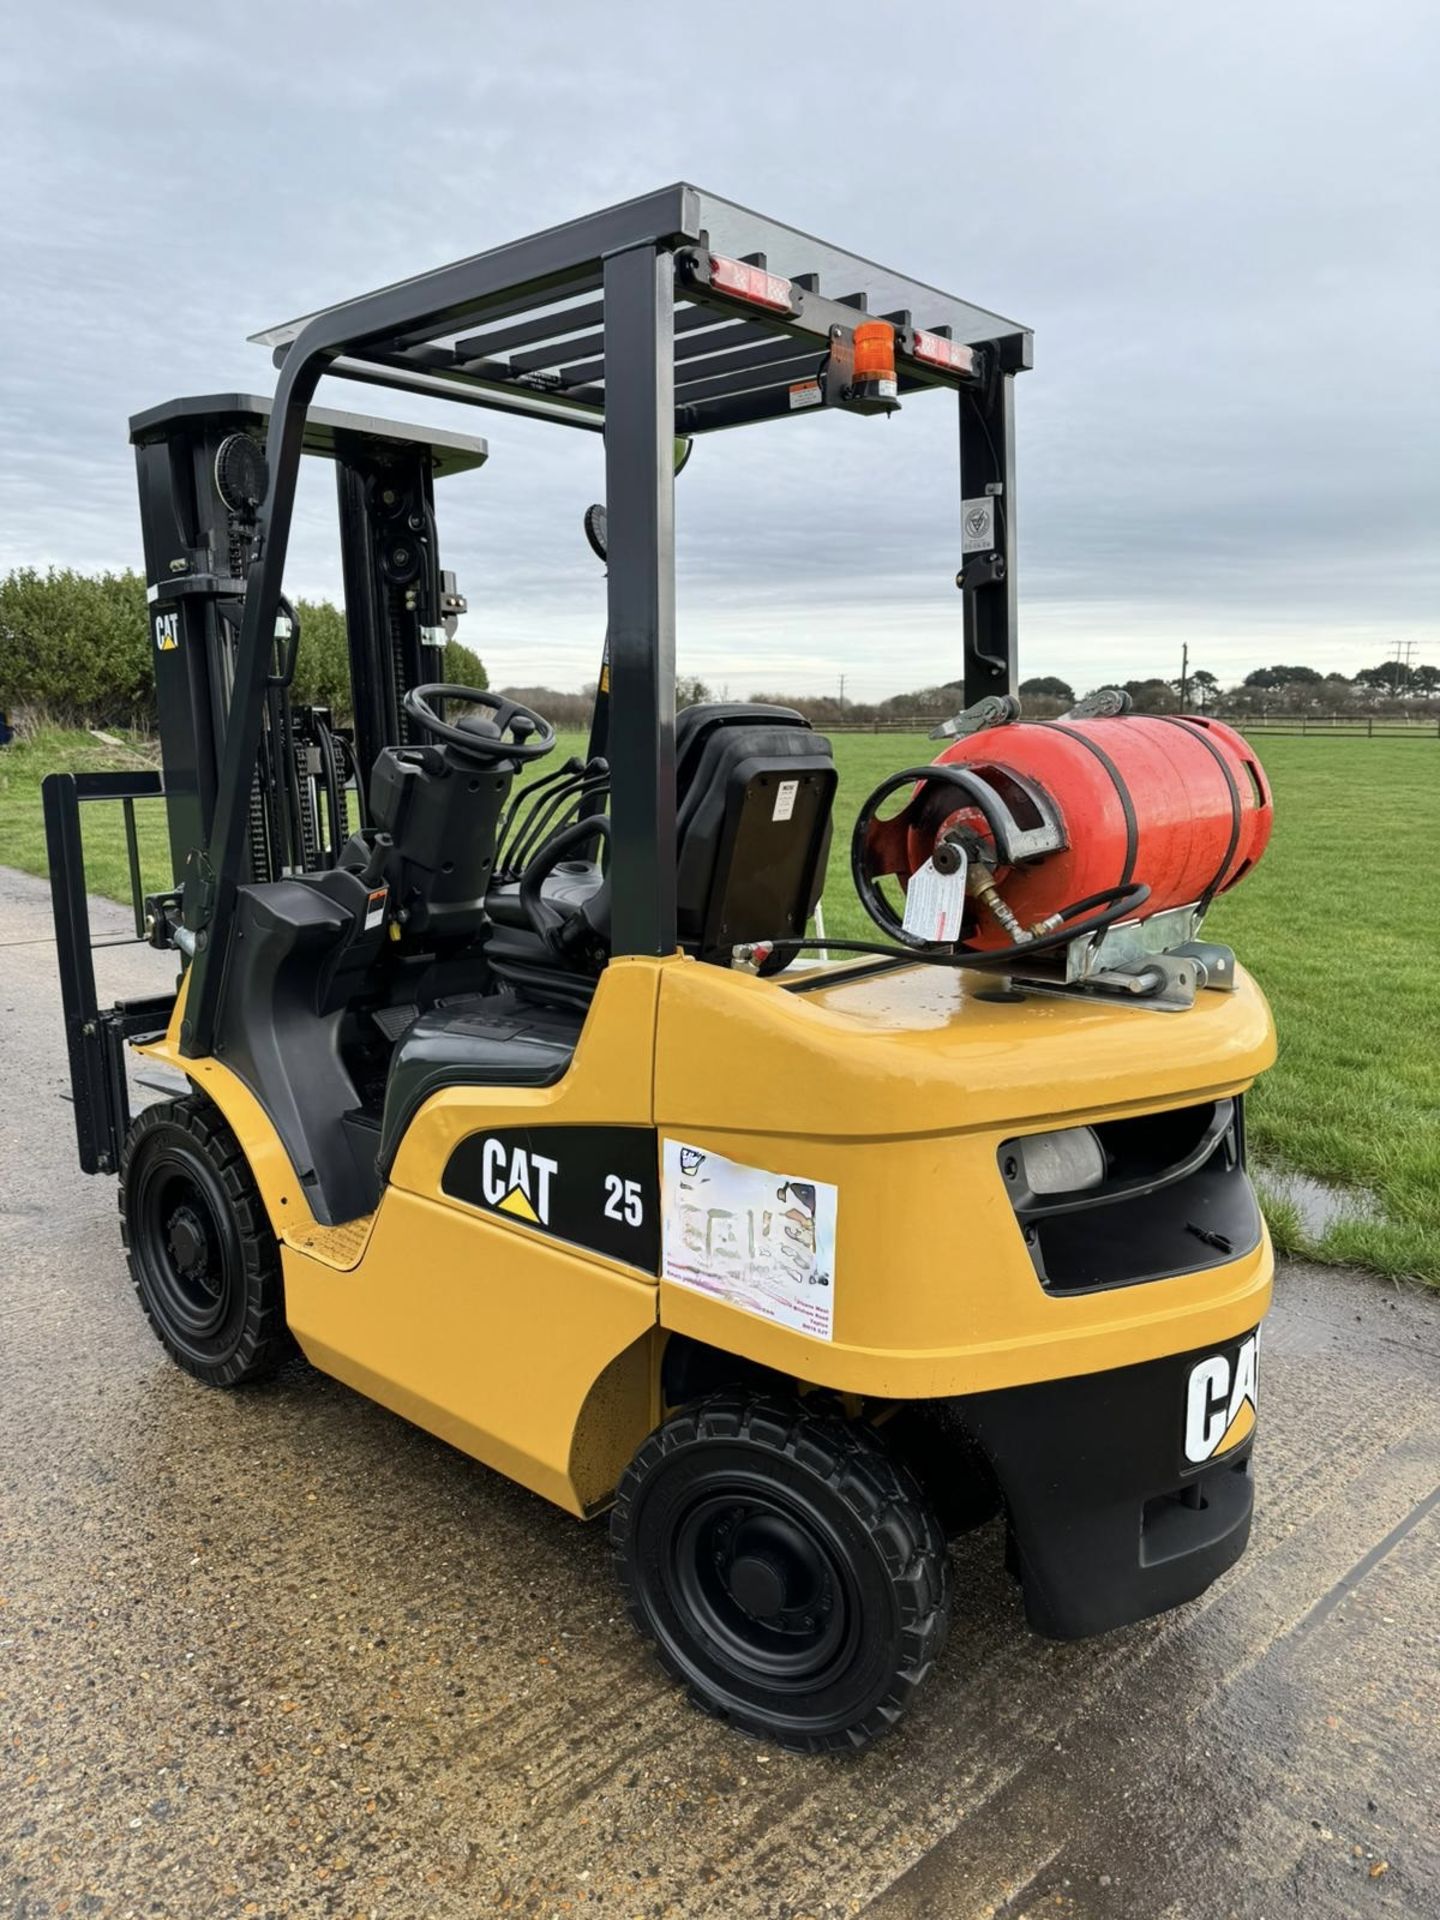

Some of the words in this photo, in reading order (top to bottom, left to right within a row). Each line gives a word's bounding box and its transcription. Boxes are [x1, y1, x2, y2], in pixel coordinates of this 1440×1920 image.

[155, 612, 178, 651] CAT
[482, 1138, 558, 1226] CAT
[604, 1174, 643, 1227] 25
